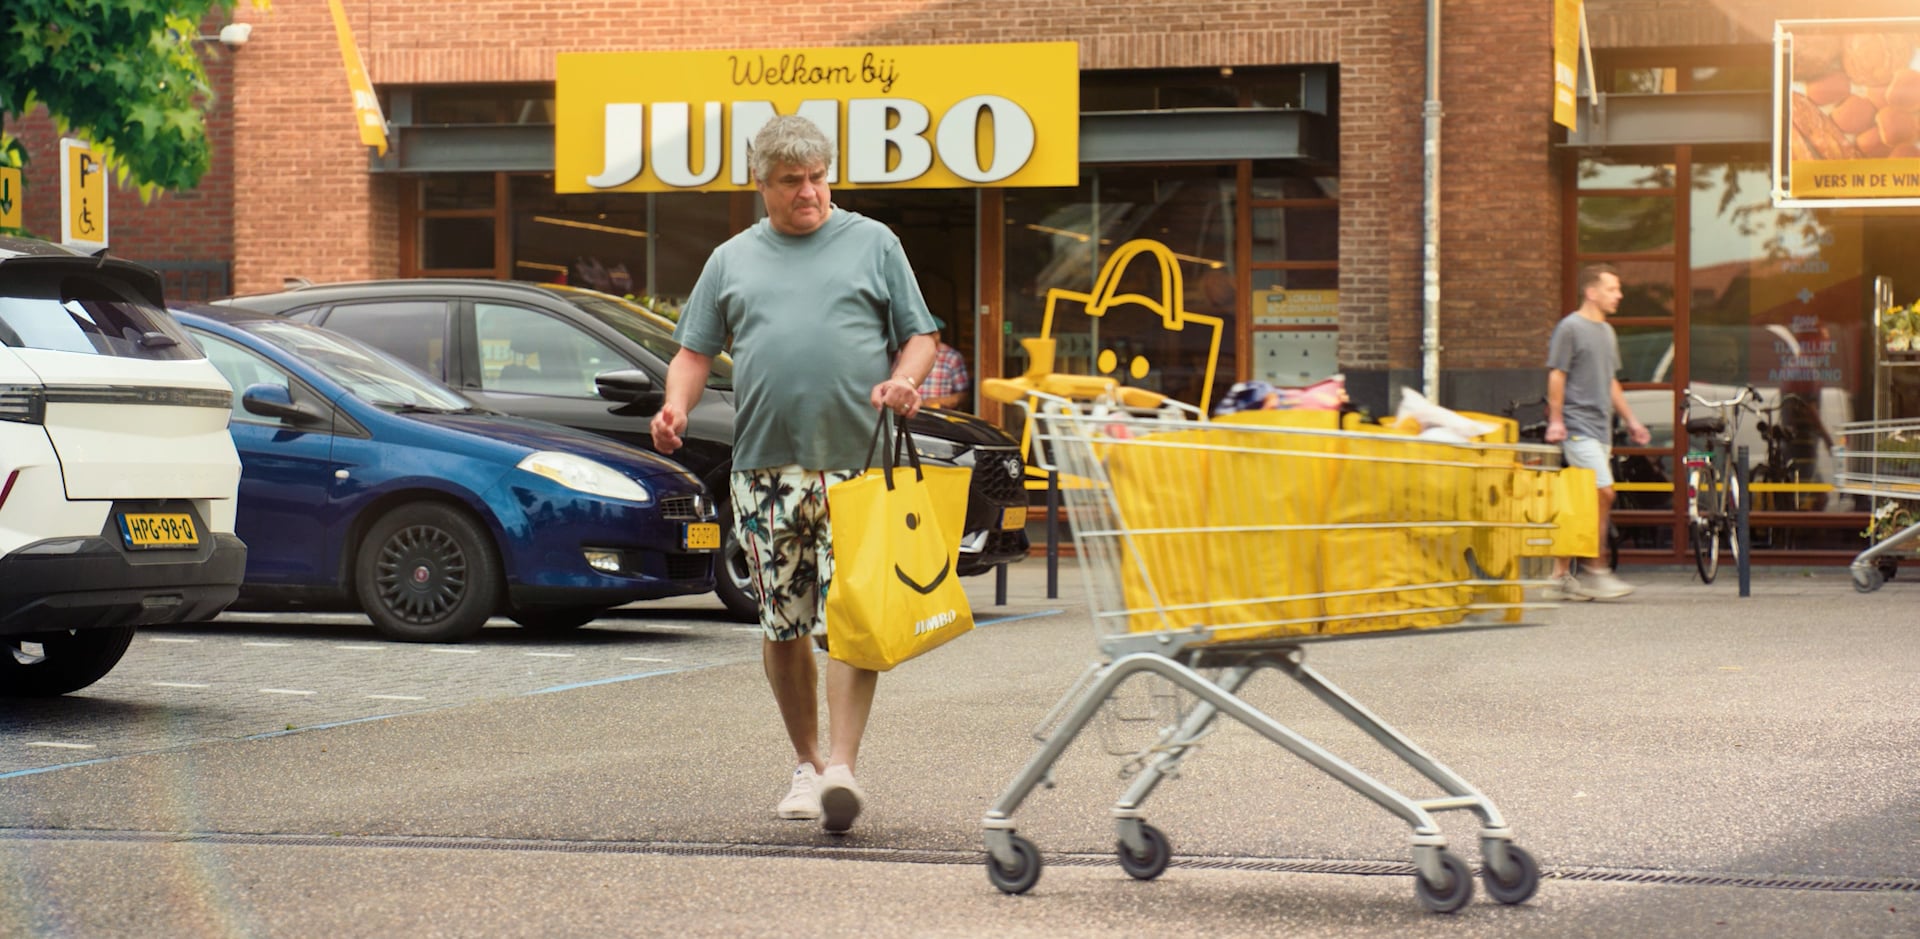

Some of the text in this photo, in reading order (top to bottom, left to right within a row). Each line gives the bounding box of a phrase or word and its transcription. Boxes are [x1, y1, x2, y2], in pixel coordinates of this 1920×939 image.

[728, 52, 900, 93] Welkom bij
[80, 153, 92, 188] P
[1814, 174, 1848, 189] VERS
[1852, 174, 1866, 188] IN
[1870, 174, 1887, 188] DE
[130, 517, 194, 540] HPG-98-Q
[914, 609, 957, 636] JUMBO
